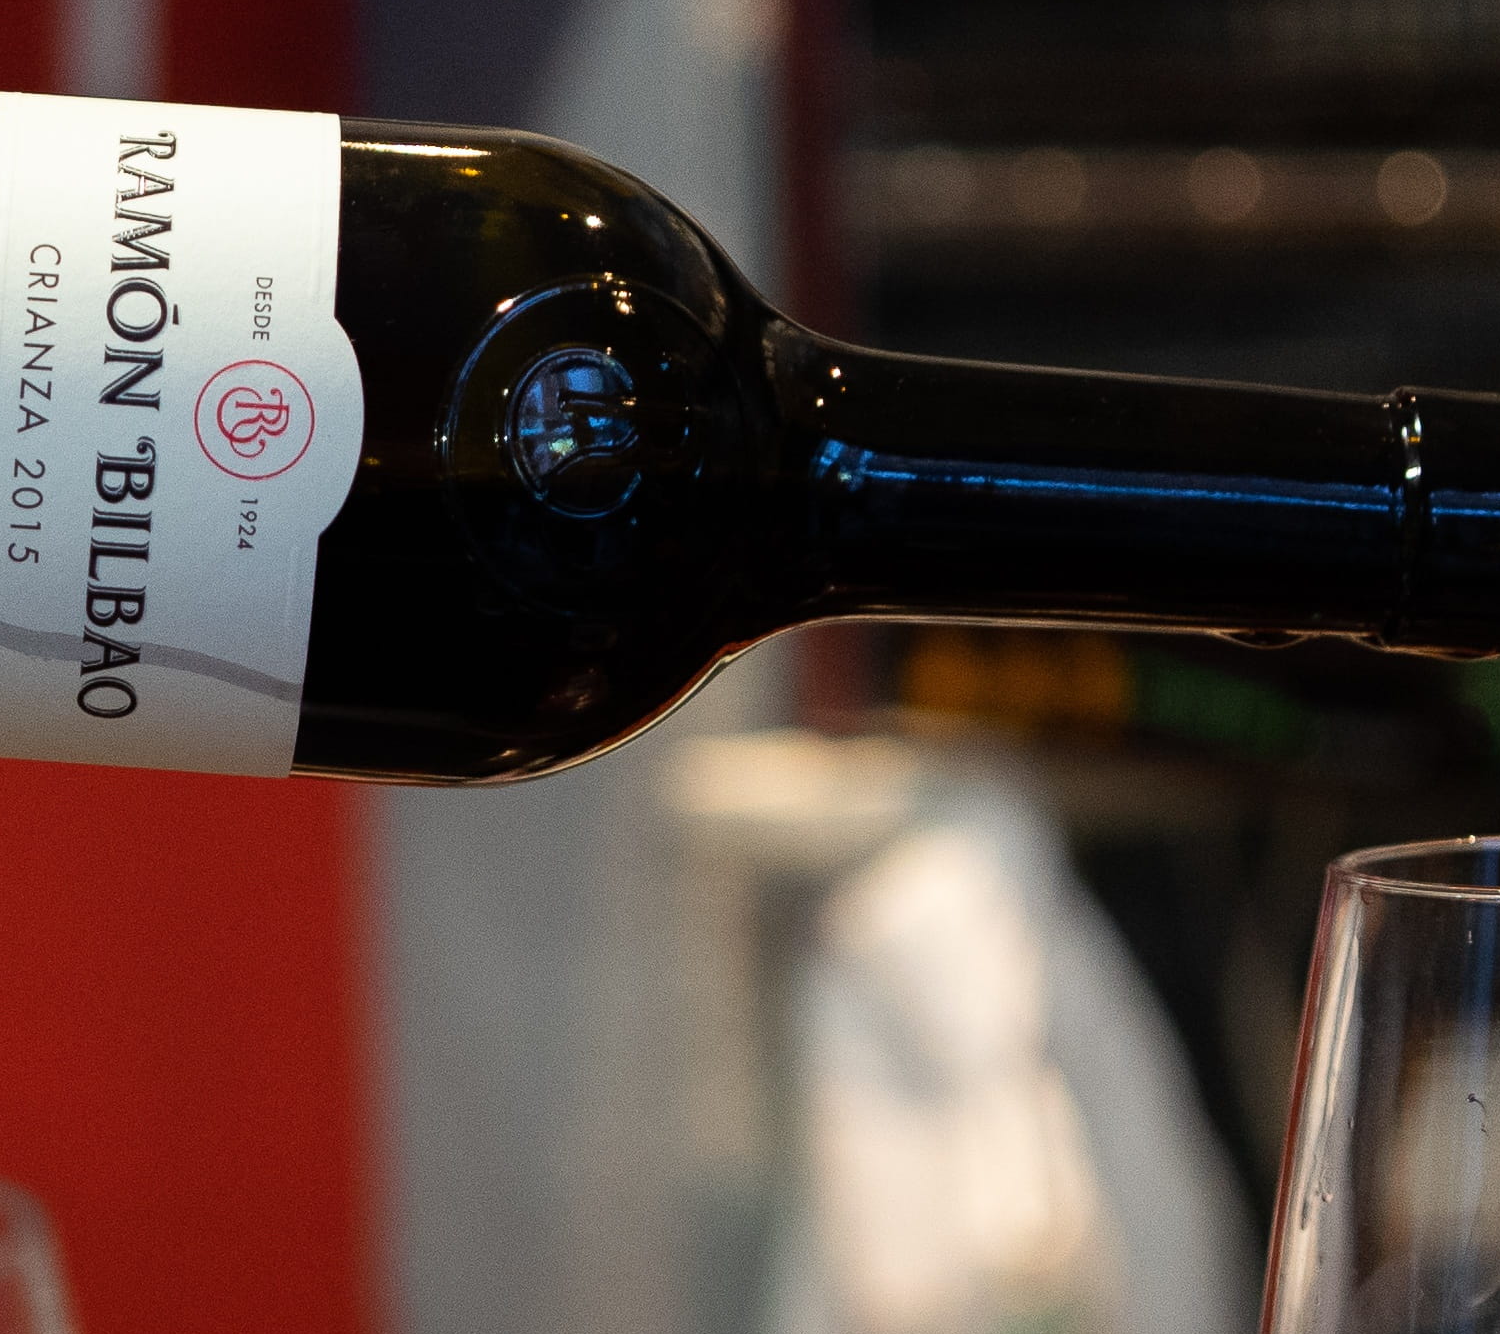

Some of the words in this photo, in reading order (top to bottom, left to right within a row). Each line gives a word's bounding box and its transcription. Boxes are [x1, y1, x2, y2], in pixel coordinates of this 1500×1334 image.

[16, 243, 63, 435] CRIANZA
[99, 130, 179, 412] RAMÓN
[252, 276, 274, 341] DESDE
[7, 458, 47, 565] 2015
[76, 436, 158, 720] BILBAO
[237, 499, 259, 550] 1924
